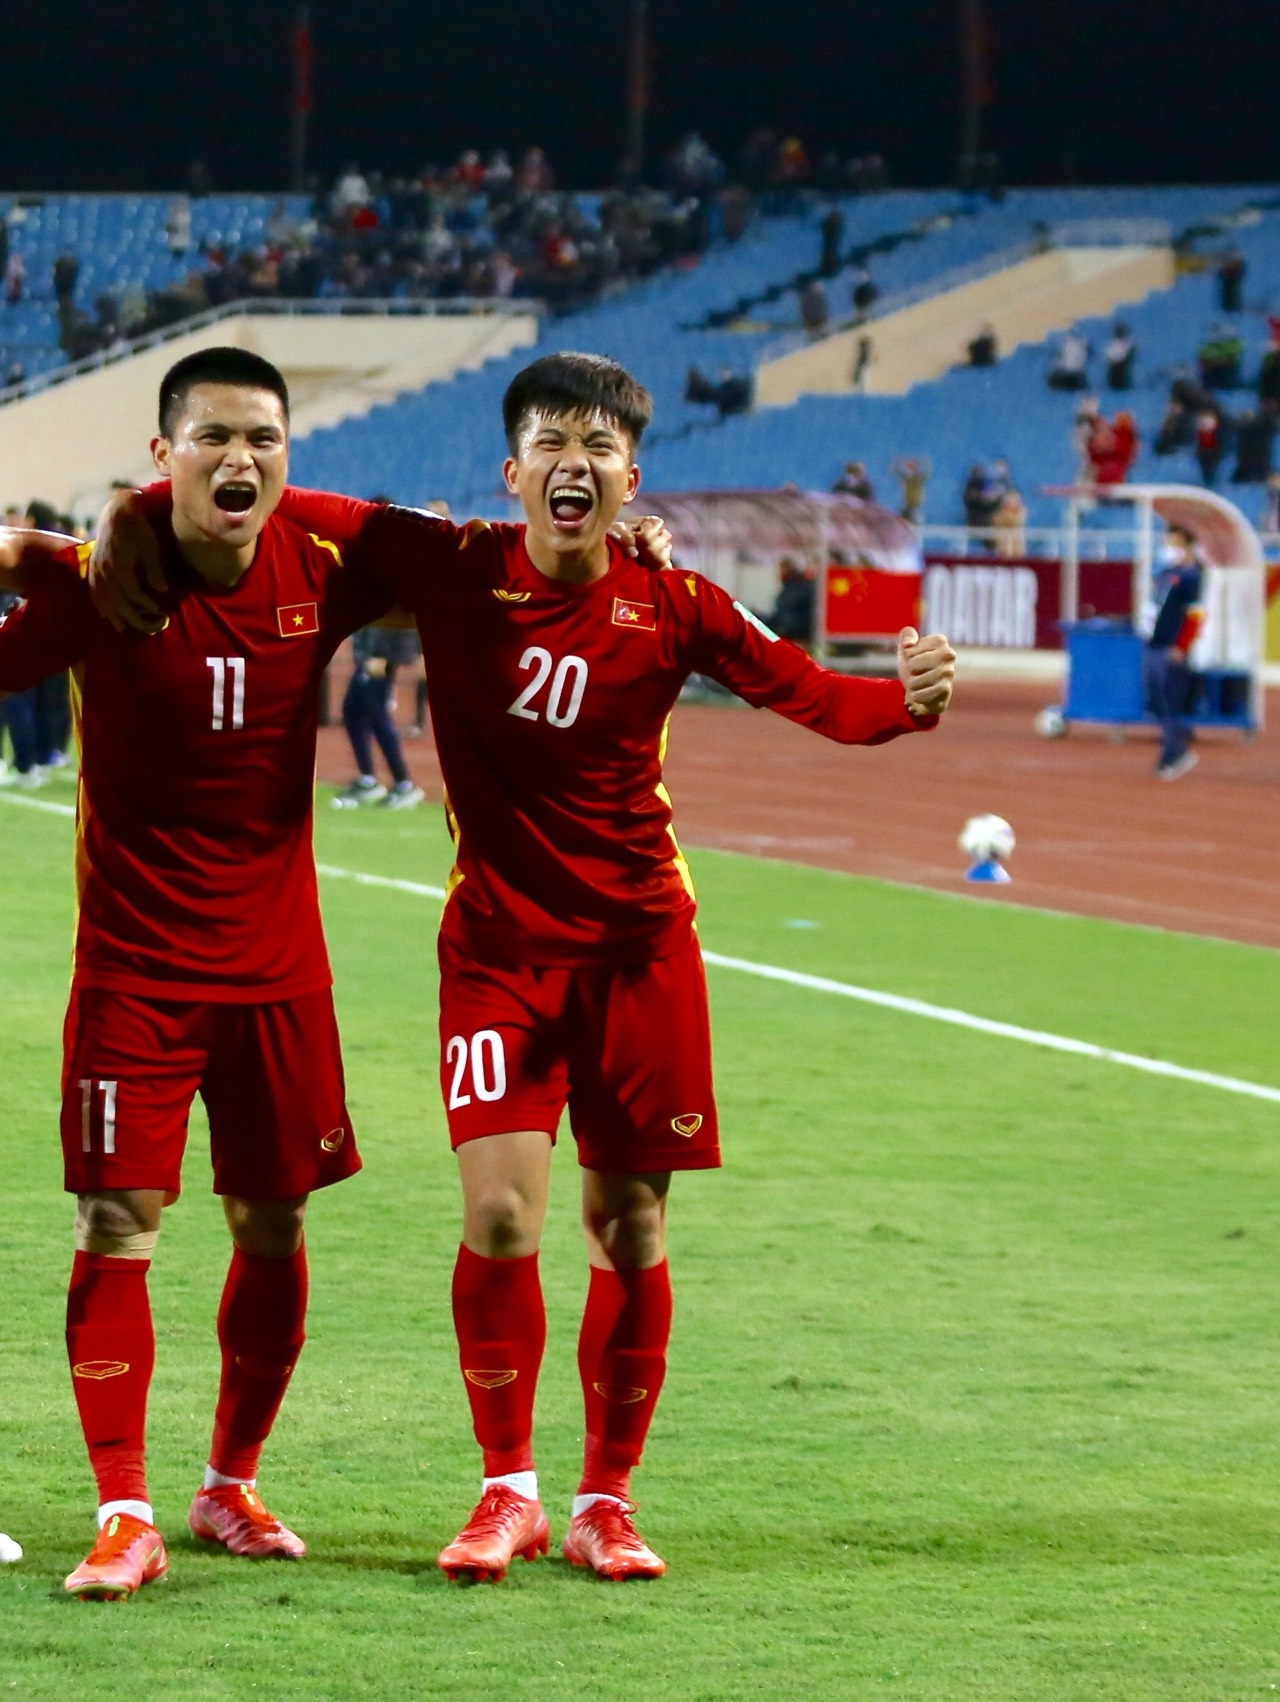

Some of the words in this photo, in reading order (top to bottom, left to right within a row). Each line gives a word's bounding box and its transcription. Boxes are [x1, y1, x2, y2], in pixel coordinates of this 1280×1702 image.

[923, 563, 1038, 648] QATAR
[206, 657, 245, 730] 11
[506, 646, 589, 729] 20
[446, 1029, 507, 1111] 20
[77, 1079, 117, 1154] 11
